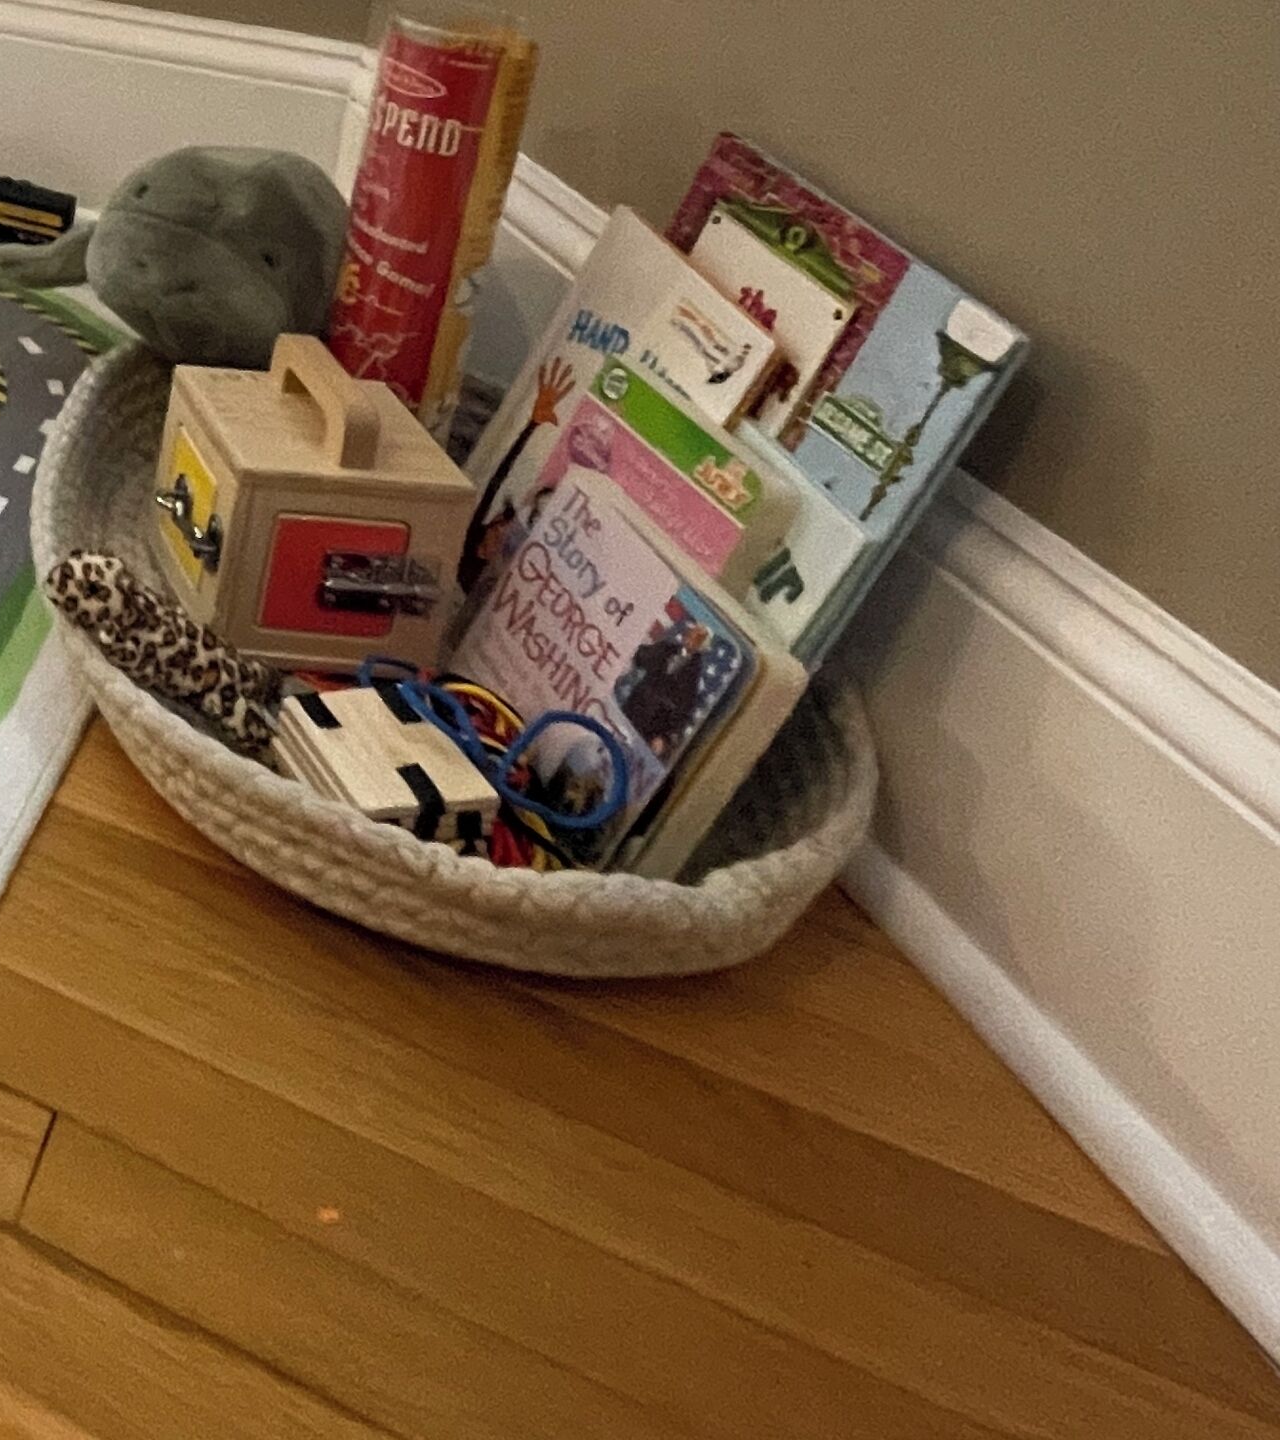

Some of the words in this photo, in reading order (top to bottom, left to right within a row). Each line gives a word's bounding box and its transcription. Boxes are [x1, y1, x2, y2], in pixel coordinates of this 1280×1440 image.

[568, 309, 630, 355] HAND
[563, 485, 601, 537] The
[518, 542, 620, 681] GEORGE
[543, 516, 606, 599] Story
[604, 597, 634, 626] of
